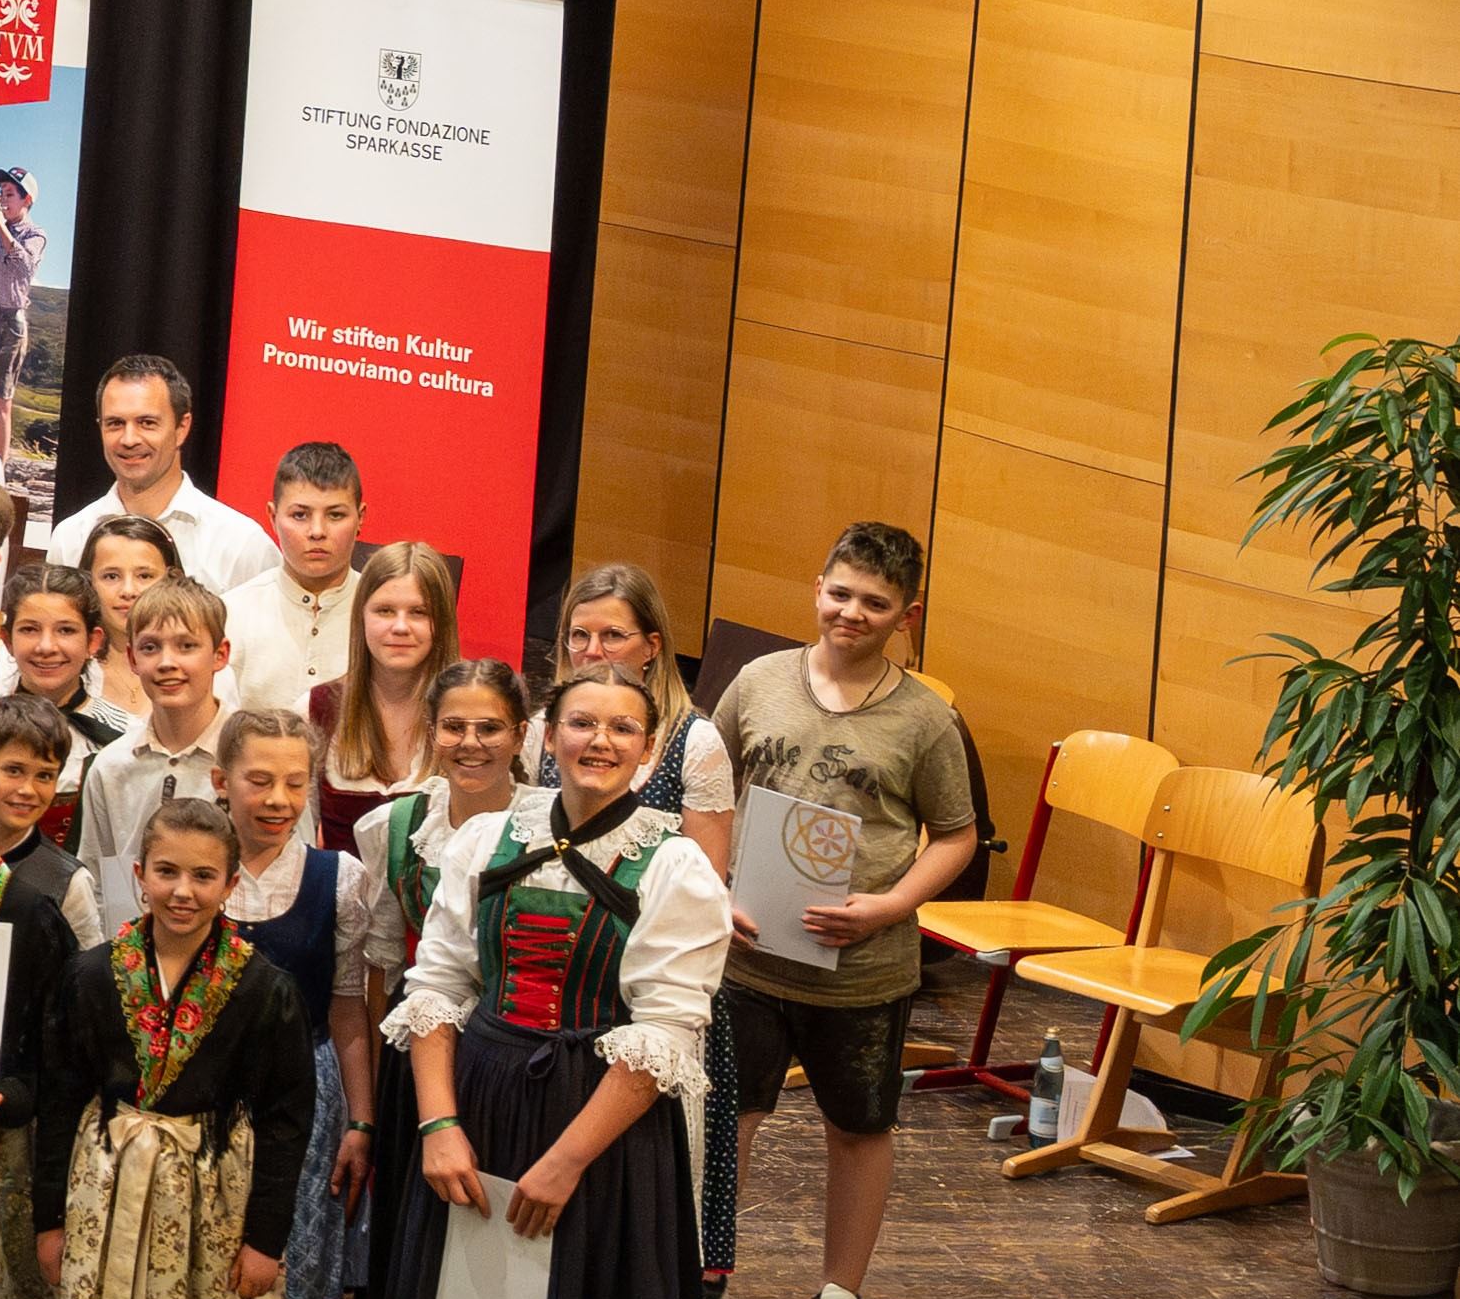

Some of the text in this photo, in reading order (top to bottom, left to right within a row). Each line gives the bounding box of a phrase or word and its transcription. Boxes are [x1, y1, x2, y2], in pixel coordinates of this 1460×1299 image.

[301, 106, 491, 146] STIFTUNG FONDAZIONE
[346, 133, 443, 161] SPARKASSE
[288, 316, 473, 363] Wir stiften Kultur
[263, 342, 494, 397] Promuoviamo cultura
